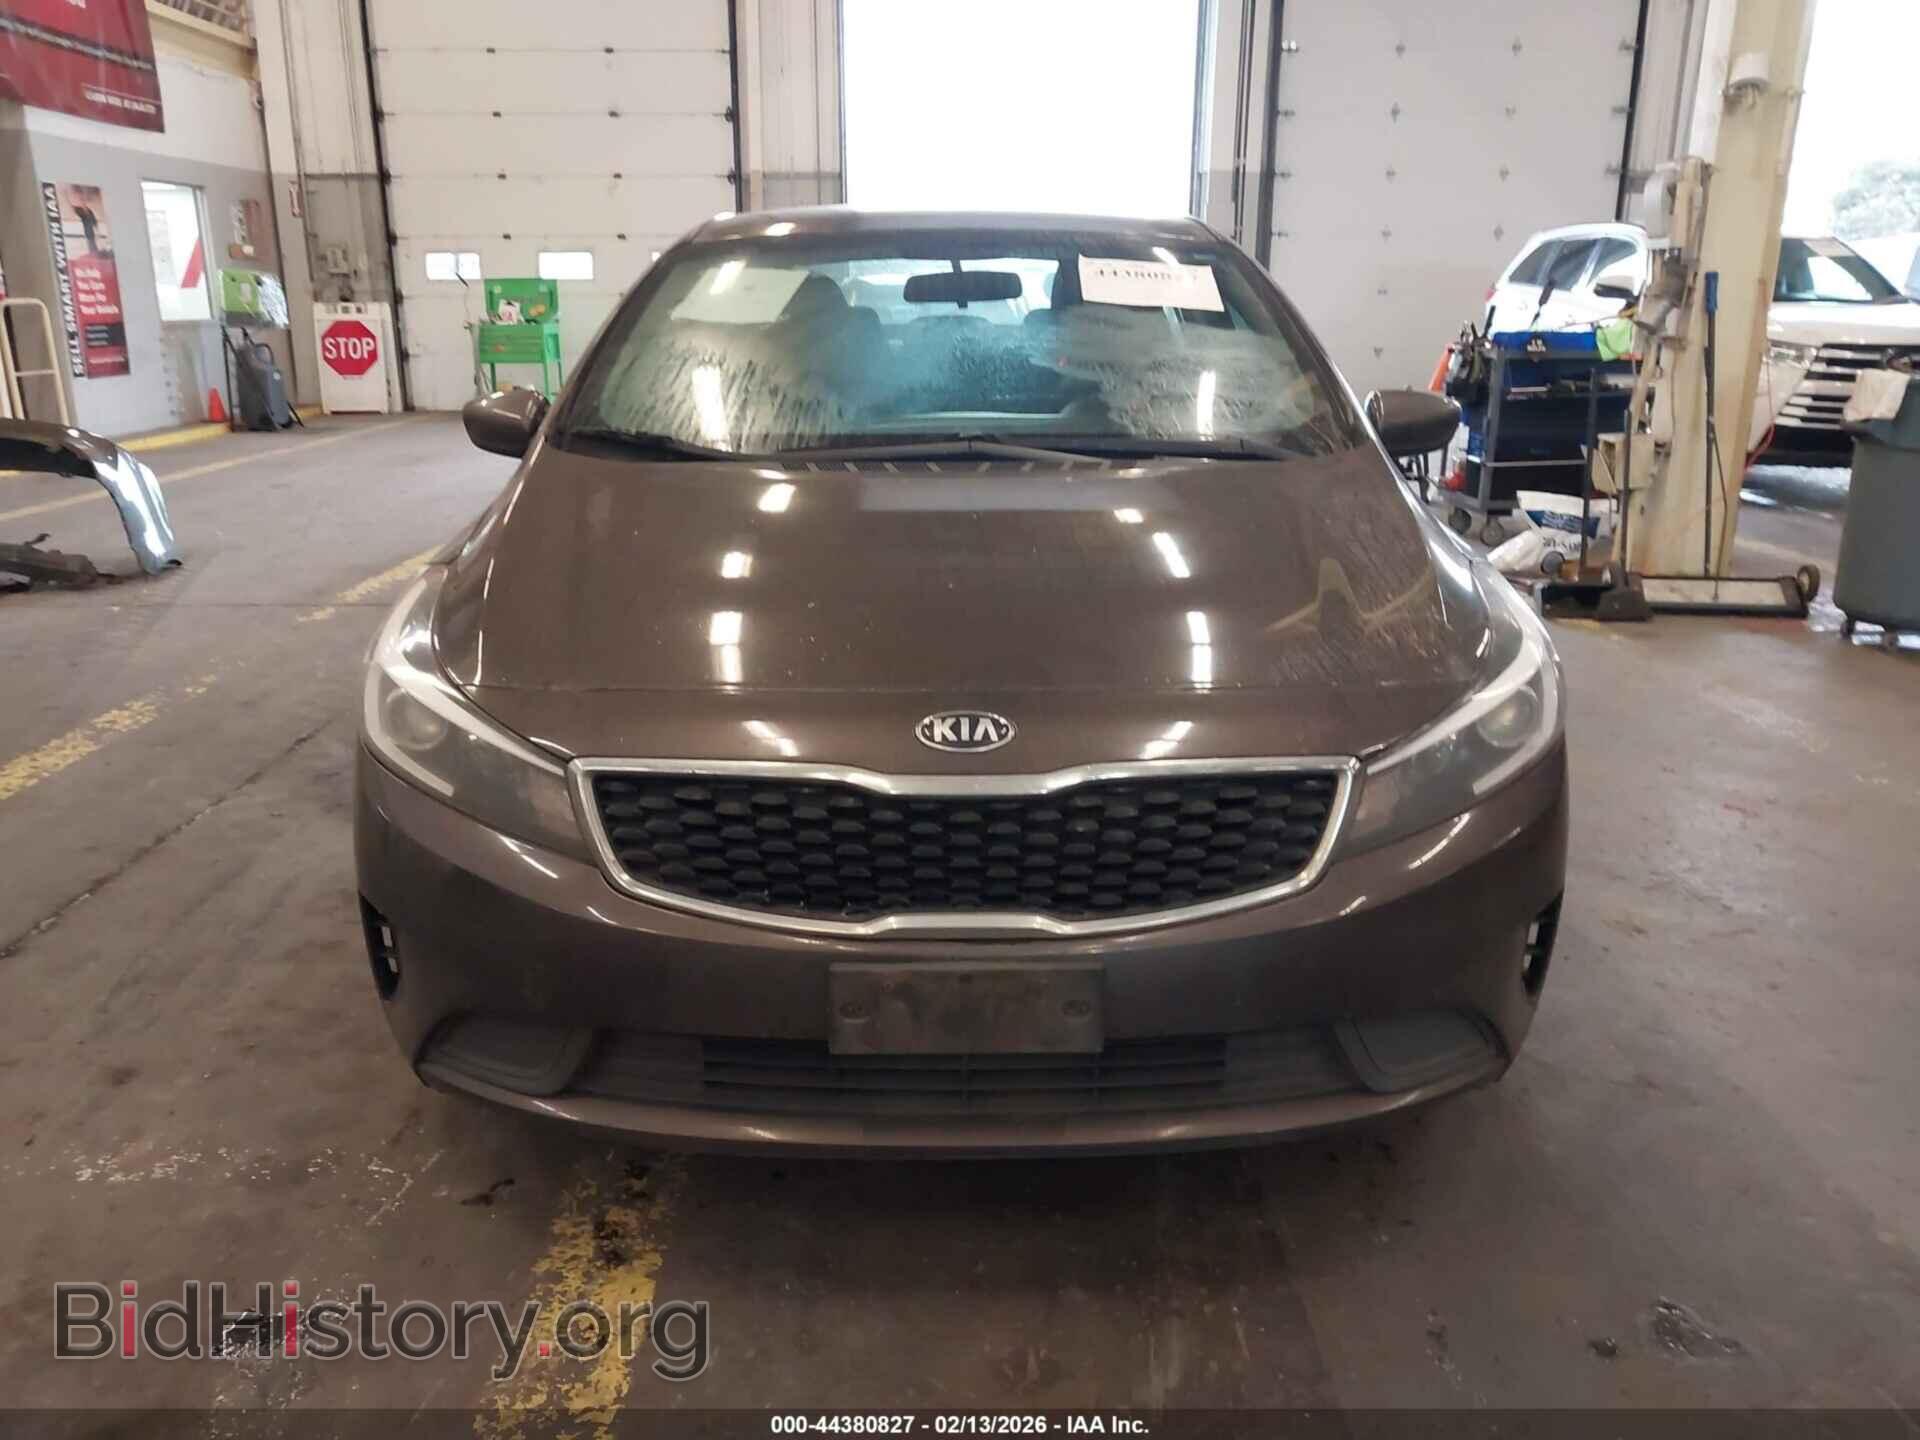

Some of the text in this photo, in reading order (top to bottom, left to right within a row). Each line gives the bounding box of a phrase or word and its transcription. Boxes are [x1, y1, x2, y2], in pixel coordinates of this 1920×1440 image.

[43, 185, 85, 375] SELL SMART WITH IAA
[323, 336, 376, 360] STOP
[932, 716, 999, 742] KIA
